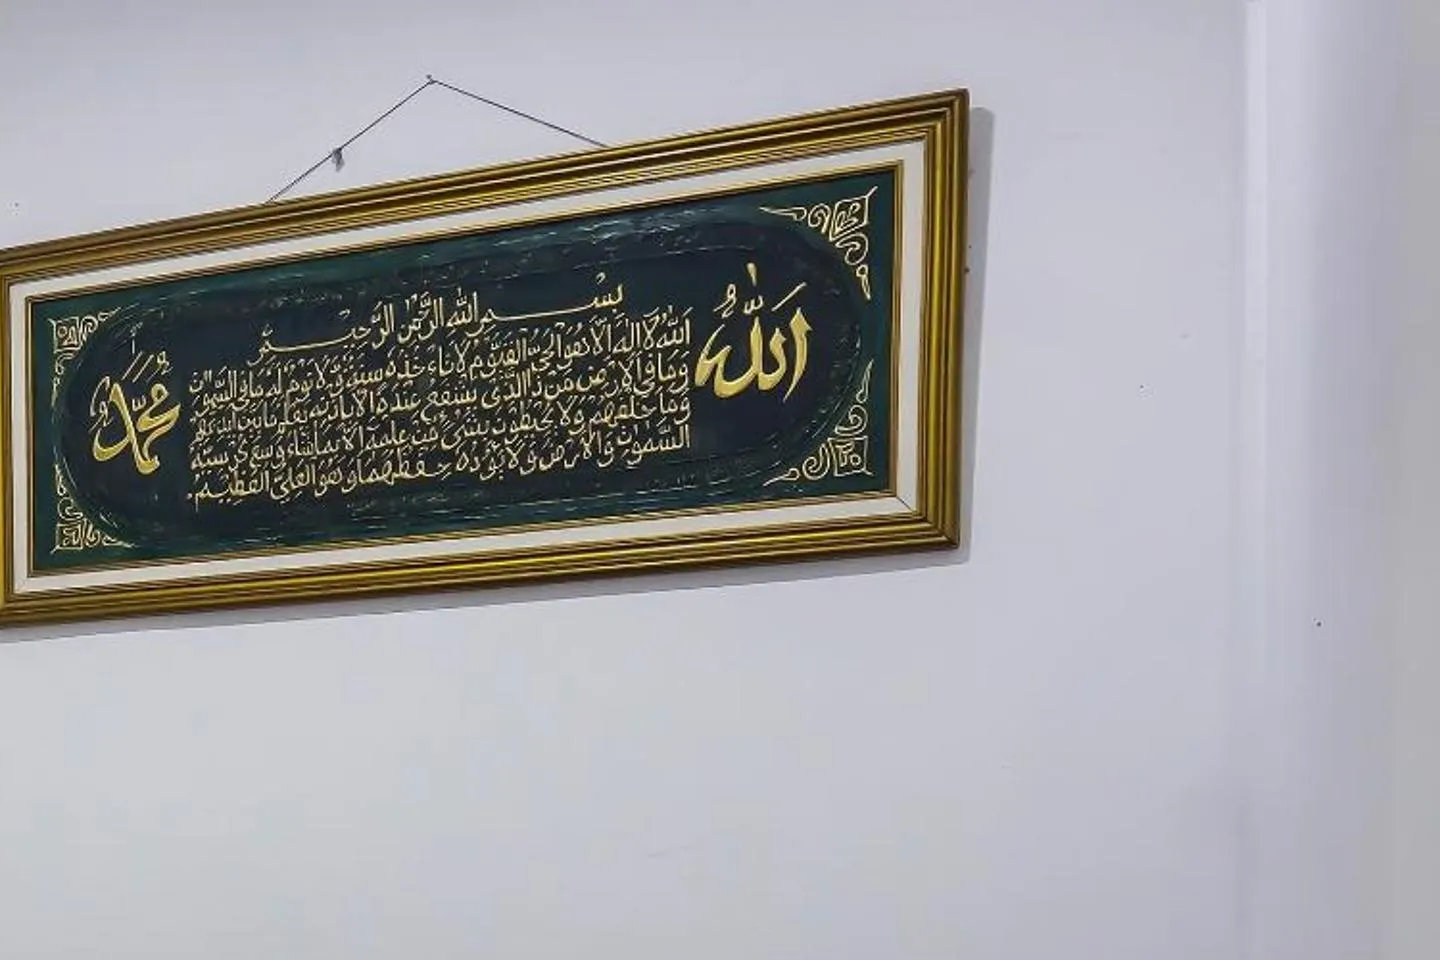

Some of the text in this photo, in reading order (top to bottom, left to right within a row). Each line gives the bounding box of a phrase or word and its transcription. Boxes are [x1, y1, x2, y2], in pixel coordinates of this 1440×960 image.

[247, 301, 394, 365] الرحيم
[397, 291, 444, 345] الرحمن
[446, 287, 477, 335] الله
[694, 262, 812, 402] الله
[90, 352, 179, 473] محمد
